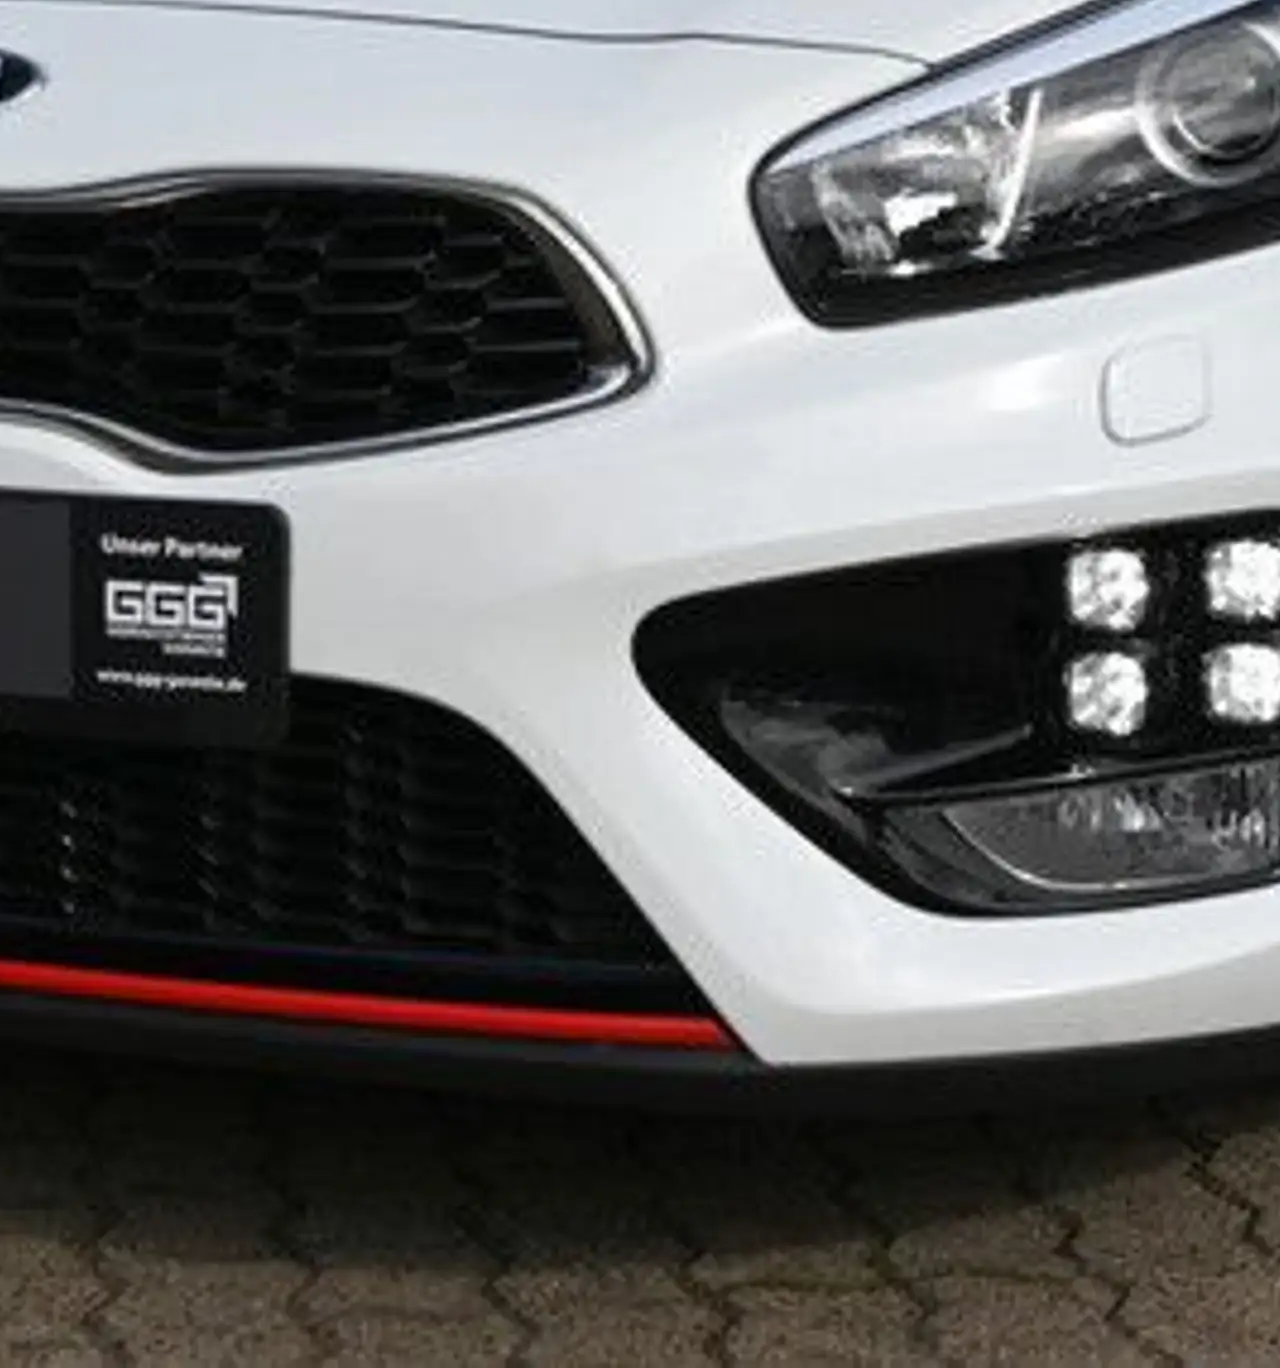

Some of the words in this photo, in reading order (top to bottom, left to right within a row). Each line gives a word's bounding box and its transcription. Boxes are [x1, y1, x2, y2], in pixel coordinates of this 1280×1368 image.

[100, 533, 161, 556] Unser
[163, 537, 243, 560] Partner
[106, 577, 231, 630] GGG
